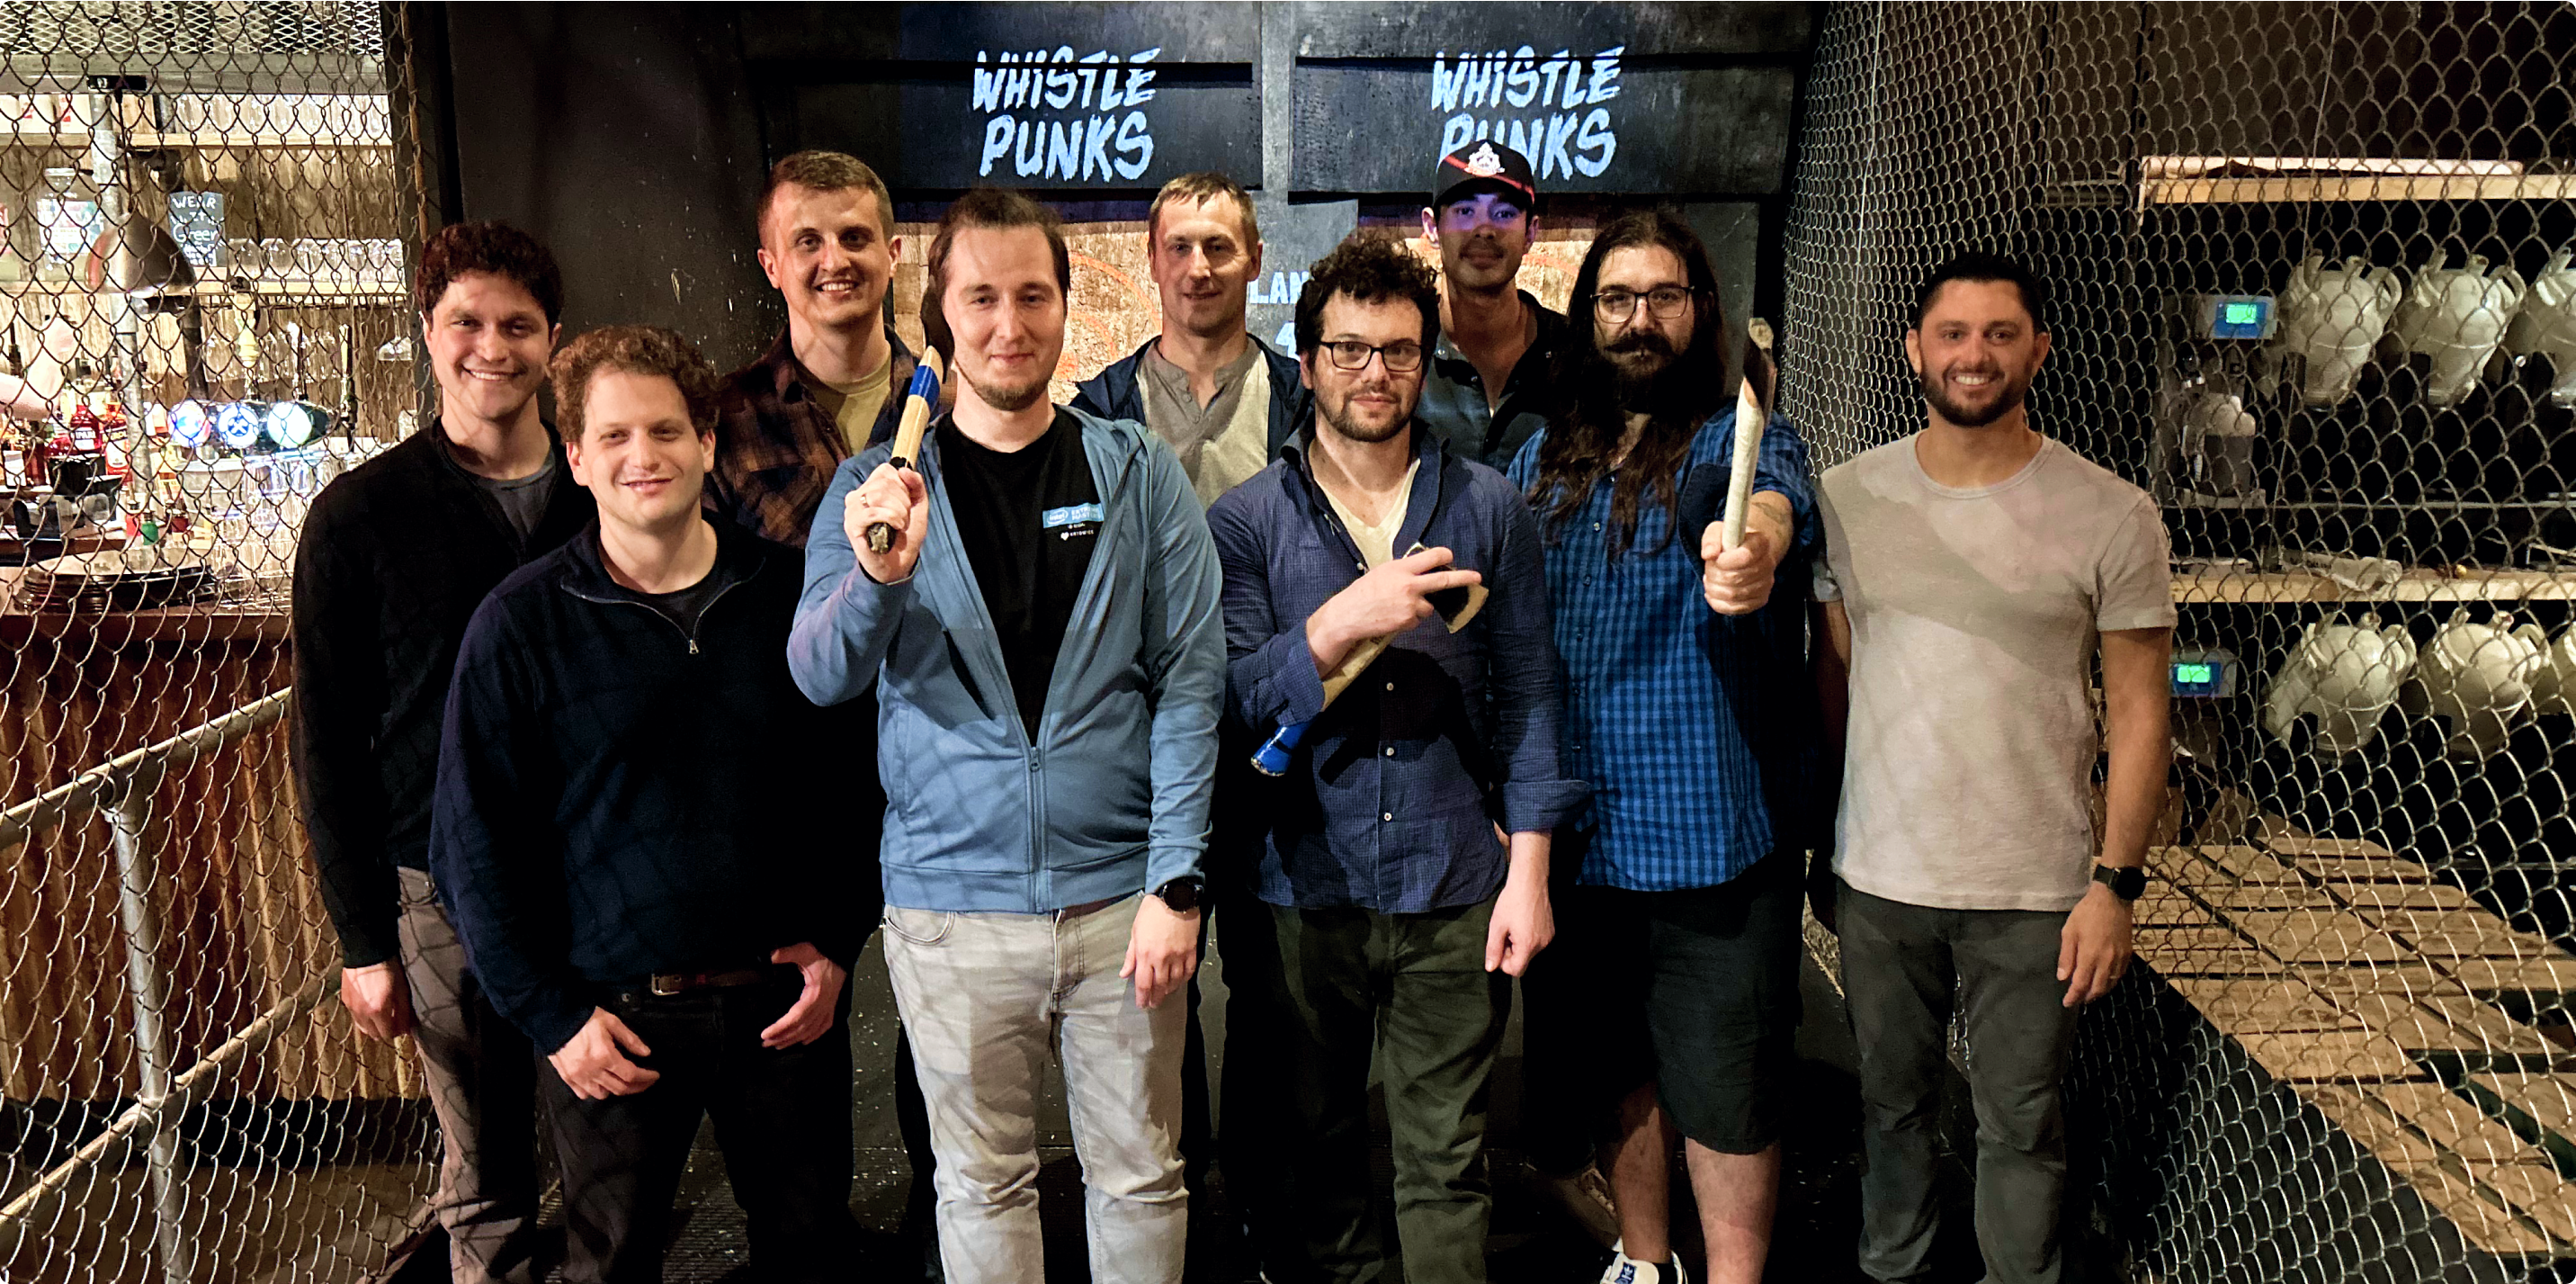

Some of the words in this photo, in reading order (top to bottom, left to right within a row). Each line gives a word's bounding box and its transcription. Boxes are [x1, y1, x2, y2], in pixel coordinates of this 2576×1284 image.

[973, 46, 1161, 113] WHISTLE
[1431, 46, 1625, 113] WHISTLE
[979, 111, 1154, 183] PUNKS
[172, 195, 216, 209] WEAR
[1249, 271, 1310, 304] LAN
